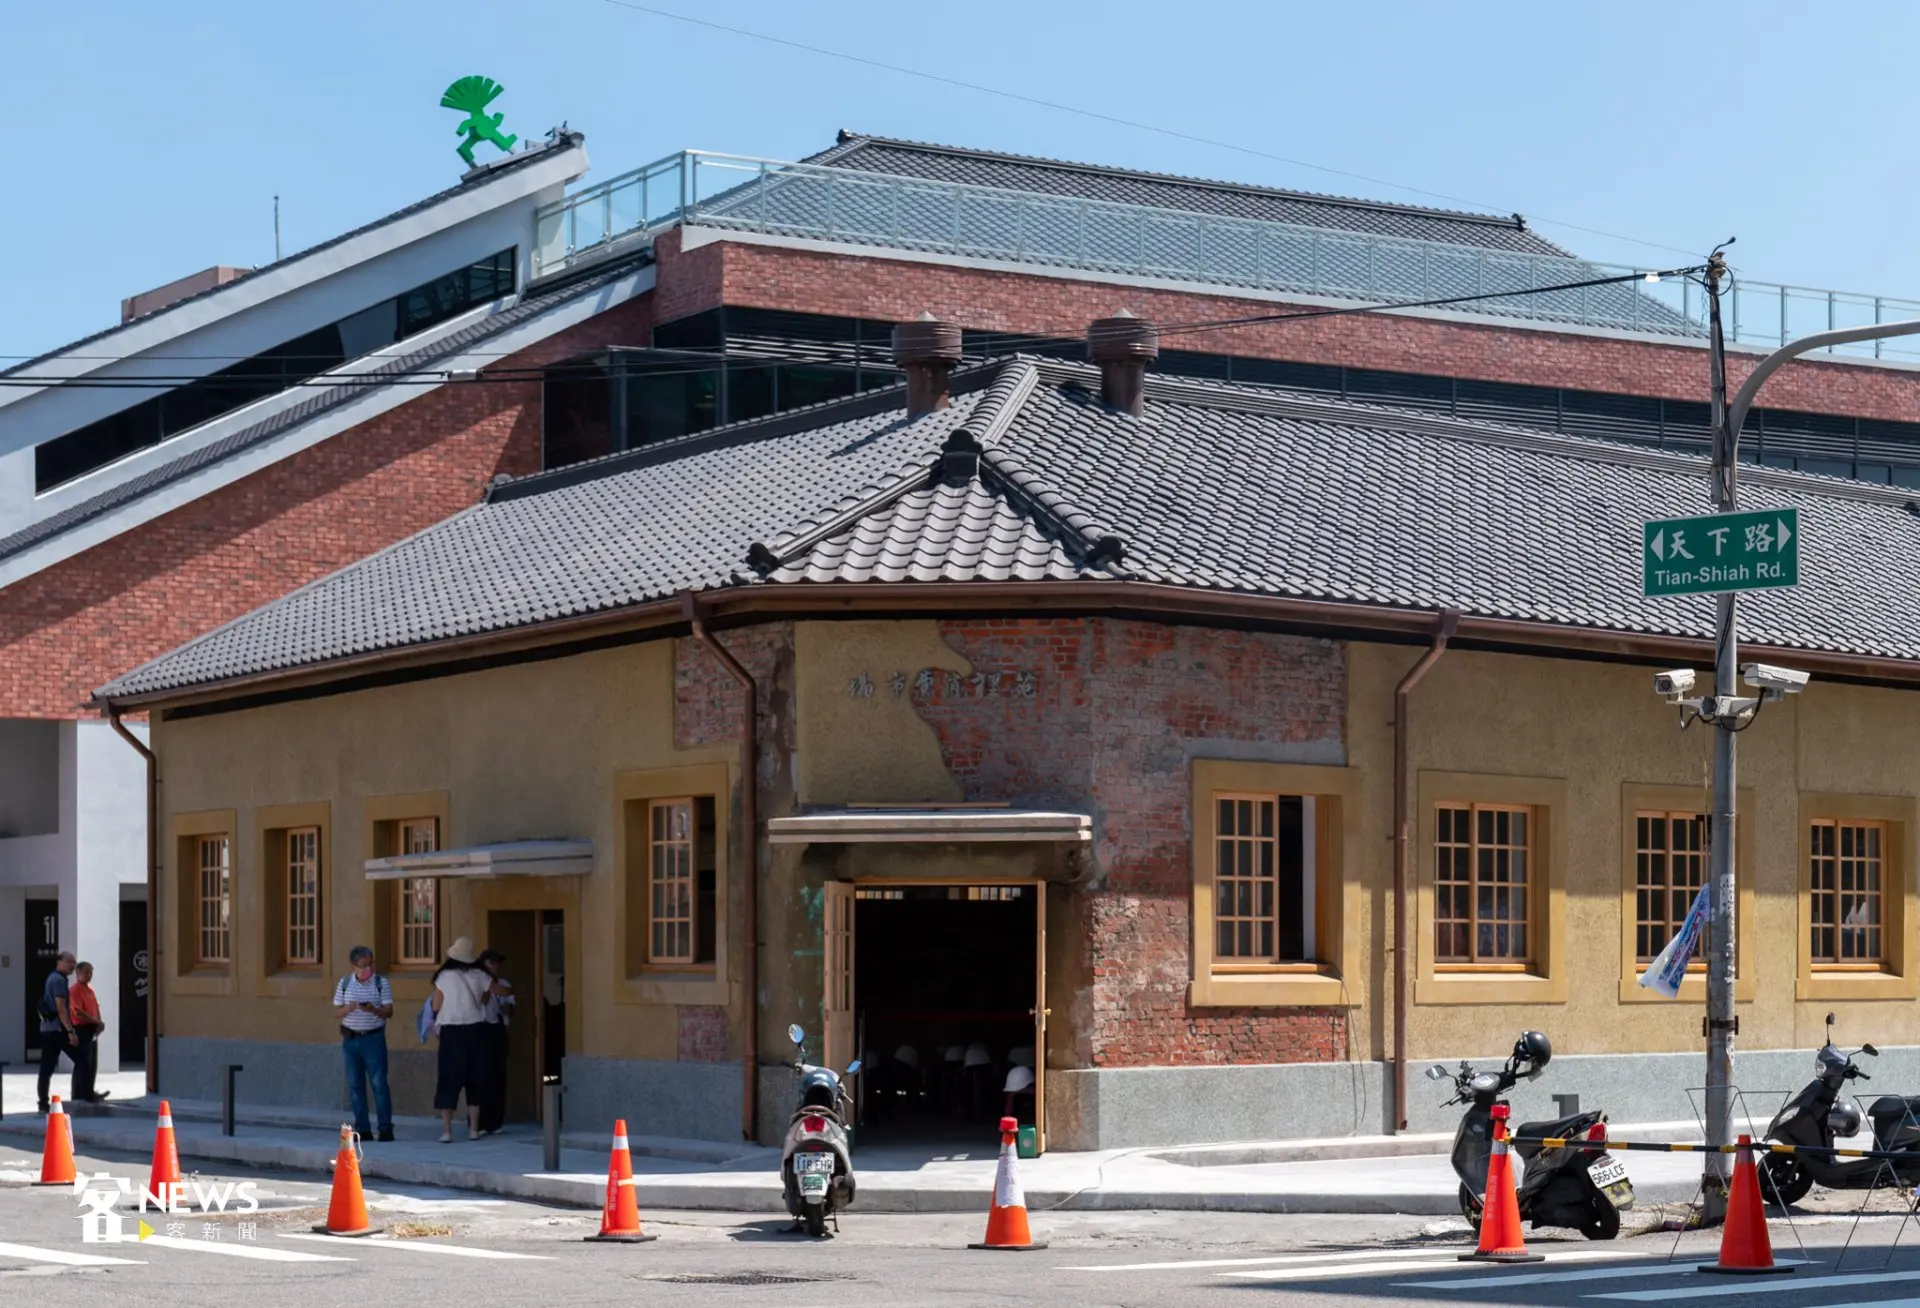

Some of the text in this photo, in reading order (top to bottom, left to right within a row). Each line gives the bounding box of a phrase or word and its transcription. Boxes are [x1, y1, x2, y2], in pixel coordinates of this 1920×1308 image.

[1668, 523, 1775, 559] 天下路
[1655, 561, 1786, 586] Tian-Shiah Rd.
